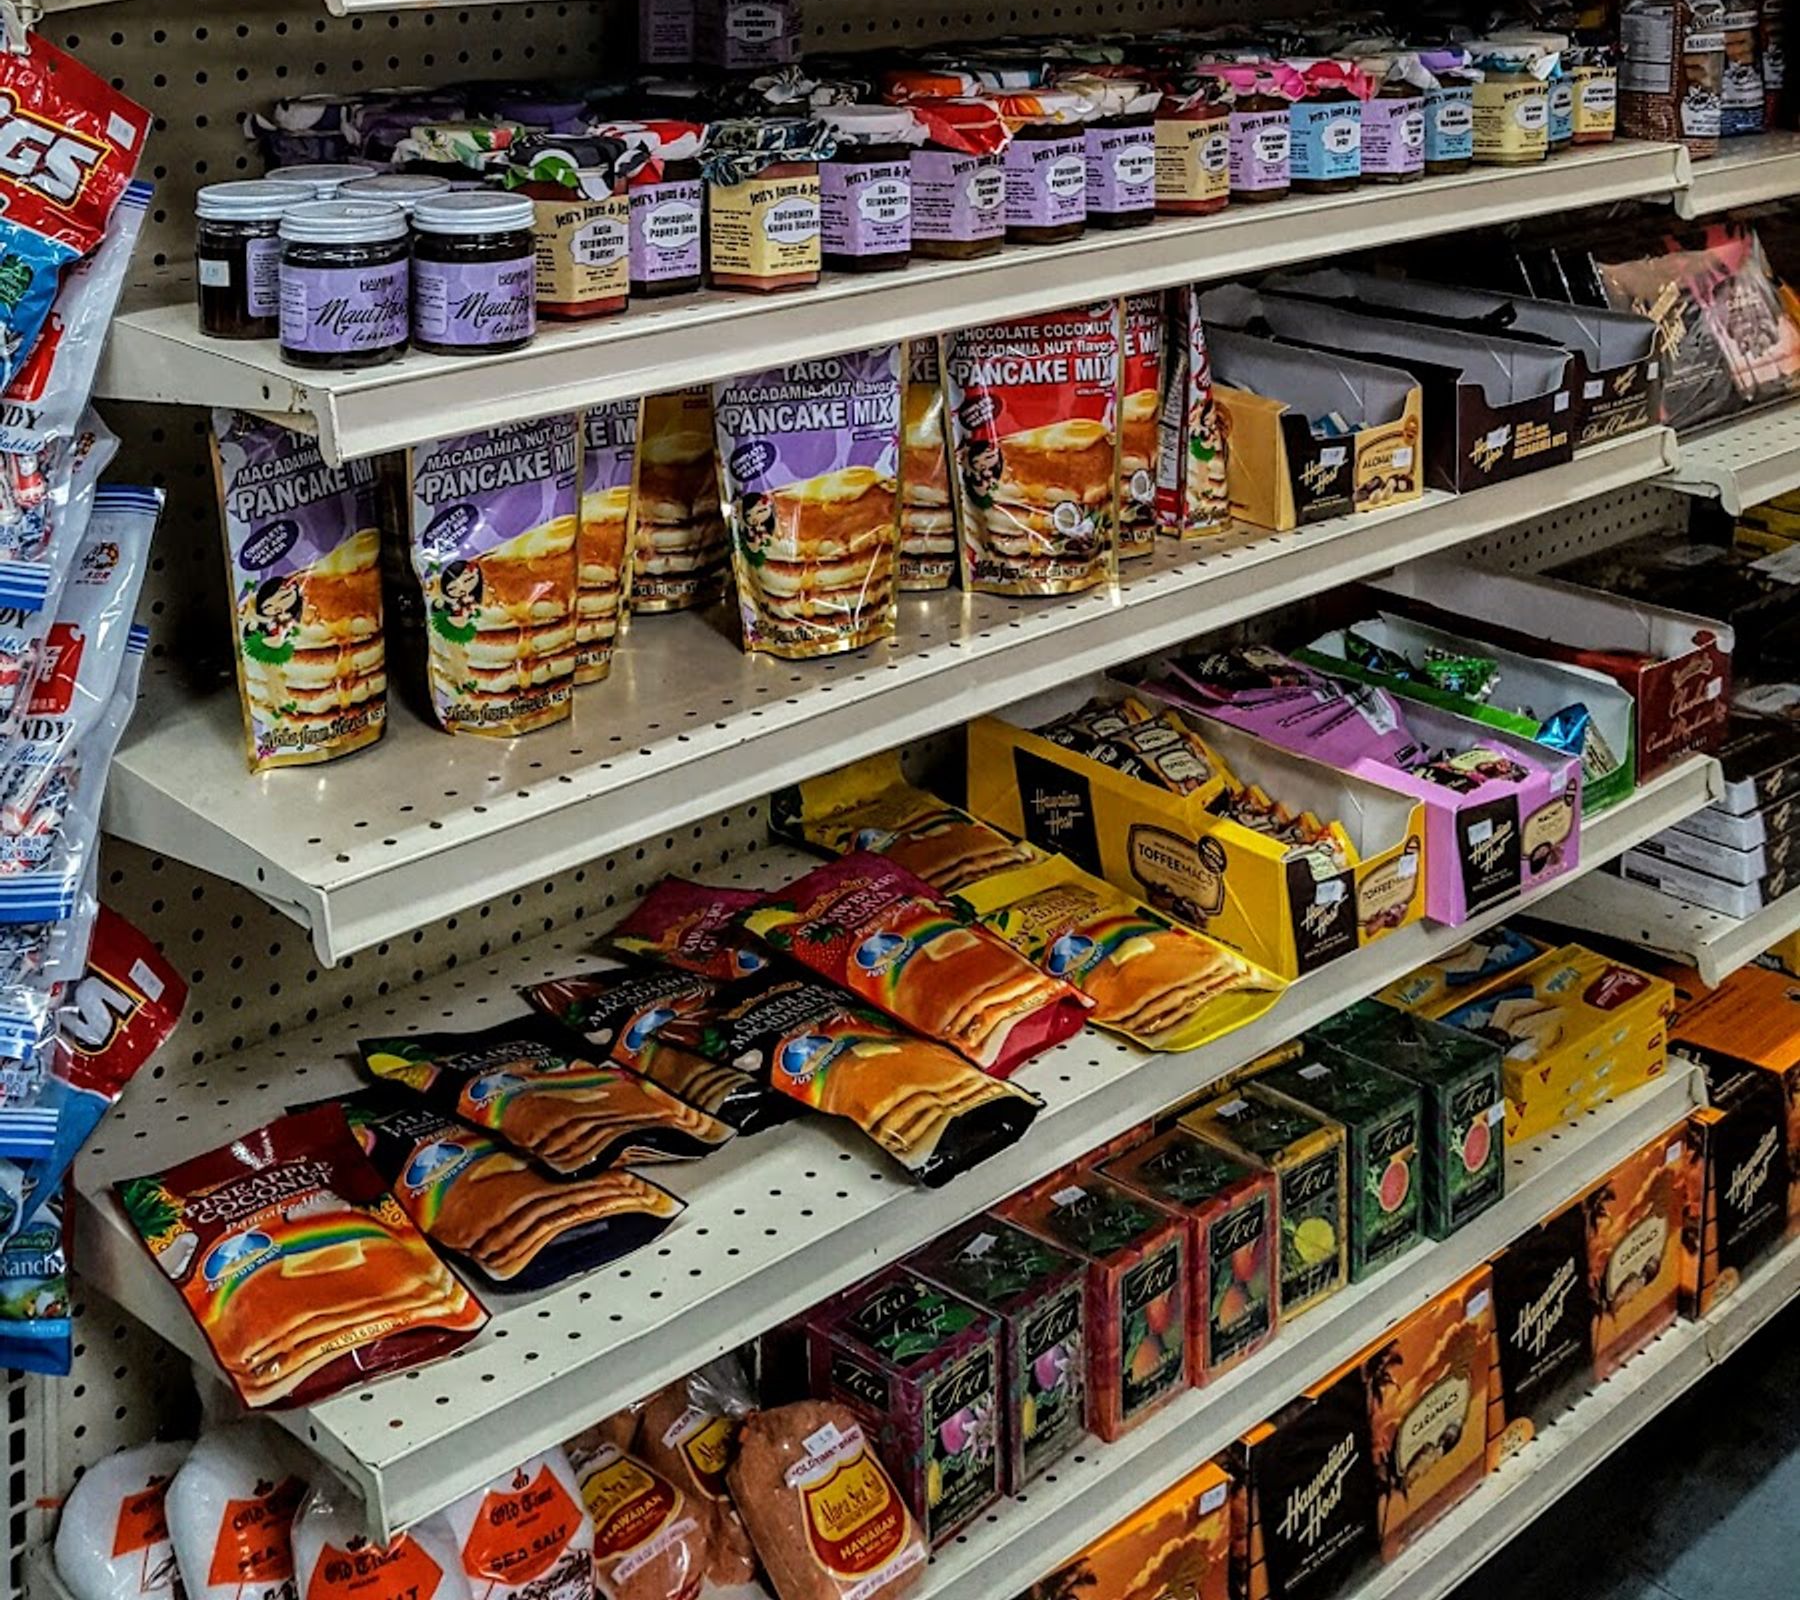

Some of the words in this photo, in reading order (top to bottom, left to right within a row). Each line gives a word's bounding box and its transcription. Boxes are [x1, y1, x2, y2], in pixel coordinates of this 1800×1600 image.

[579, 235, 625, 251] Strawberry
[650, 226, 679, 240] Papaya
[956, 325, 1040, 343] CHOCOLATE
[1043, 320, 1114, 338] COCONUT
[956, 342, 1040, 360] MACADAMIA
[1045, 341, 1072, 356] NUT
[783, 360, 841, 383] TARO
[957, 359, 1067, 387] PANCAKE
[1075, 356, 1114, 383] MIX
[726, 383, 816, 405] MACADAMIA
[820, 381, 851, 398] NUT
[726, 401, 848, 437] PANCAKE
[853, 396, 893, 427] MIX
[237, 449, 321, 487] MACADAMIA
[427, 437, 522, 473] MACADAMIA
[525, 428, 550, 449] NUT
[237, 467, 348, 524] PANCAKE
[425, 450, 552, 505] PANCAKE
[243, 523, 287, 559] COMPLETE
[271, 531, 288, 548] ADD
[1031, 787, 1081, 815] Hawaiian
[1045, 809, 1085, 836] Host
[1453, 1083, 1494, 1123] Tea
[1368, 1121, 1412, 1160] Tea
[185, 1160, 333, 1219] PINEAPPLE
[197, 1170, 332, 1224] COCONUT
[1286, 1165, 1332, 1207] Tea
[1214, 1212, 1262, 1259] Tea
[0, 1255, 58, 1278] Ranch
[231, 1262, 256, 1281] ADD
[1128, 1259, 1175, 1306] Tea
[860, 1292, 907, 1330] Tea
[1511, 1255, 1577, 1345] Hawaiian
[1530, 1274, 1579, 1356] Host
[319, 1338, 344, 1355] NET
[1027, 1302, 1075, 1356] Tea
[833, 1358, 884, 1400] Tea
[933, 1362, 987, 1420] Tea
[1277, 1431, 1355, 1540] Hawaiian
[1298, 1451, 1360, 1546] Host
[491, 1549, 528, 1572] SEA
[530, 1527, 568, 1554] SALT
[839, 1514, 898, 1561] HAWAIIAN
